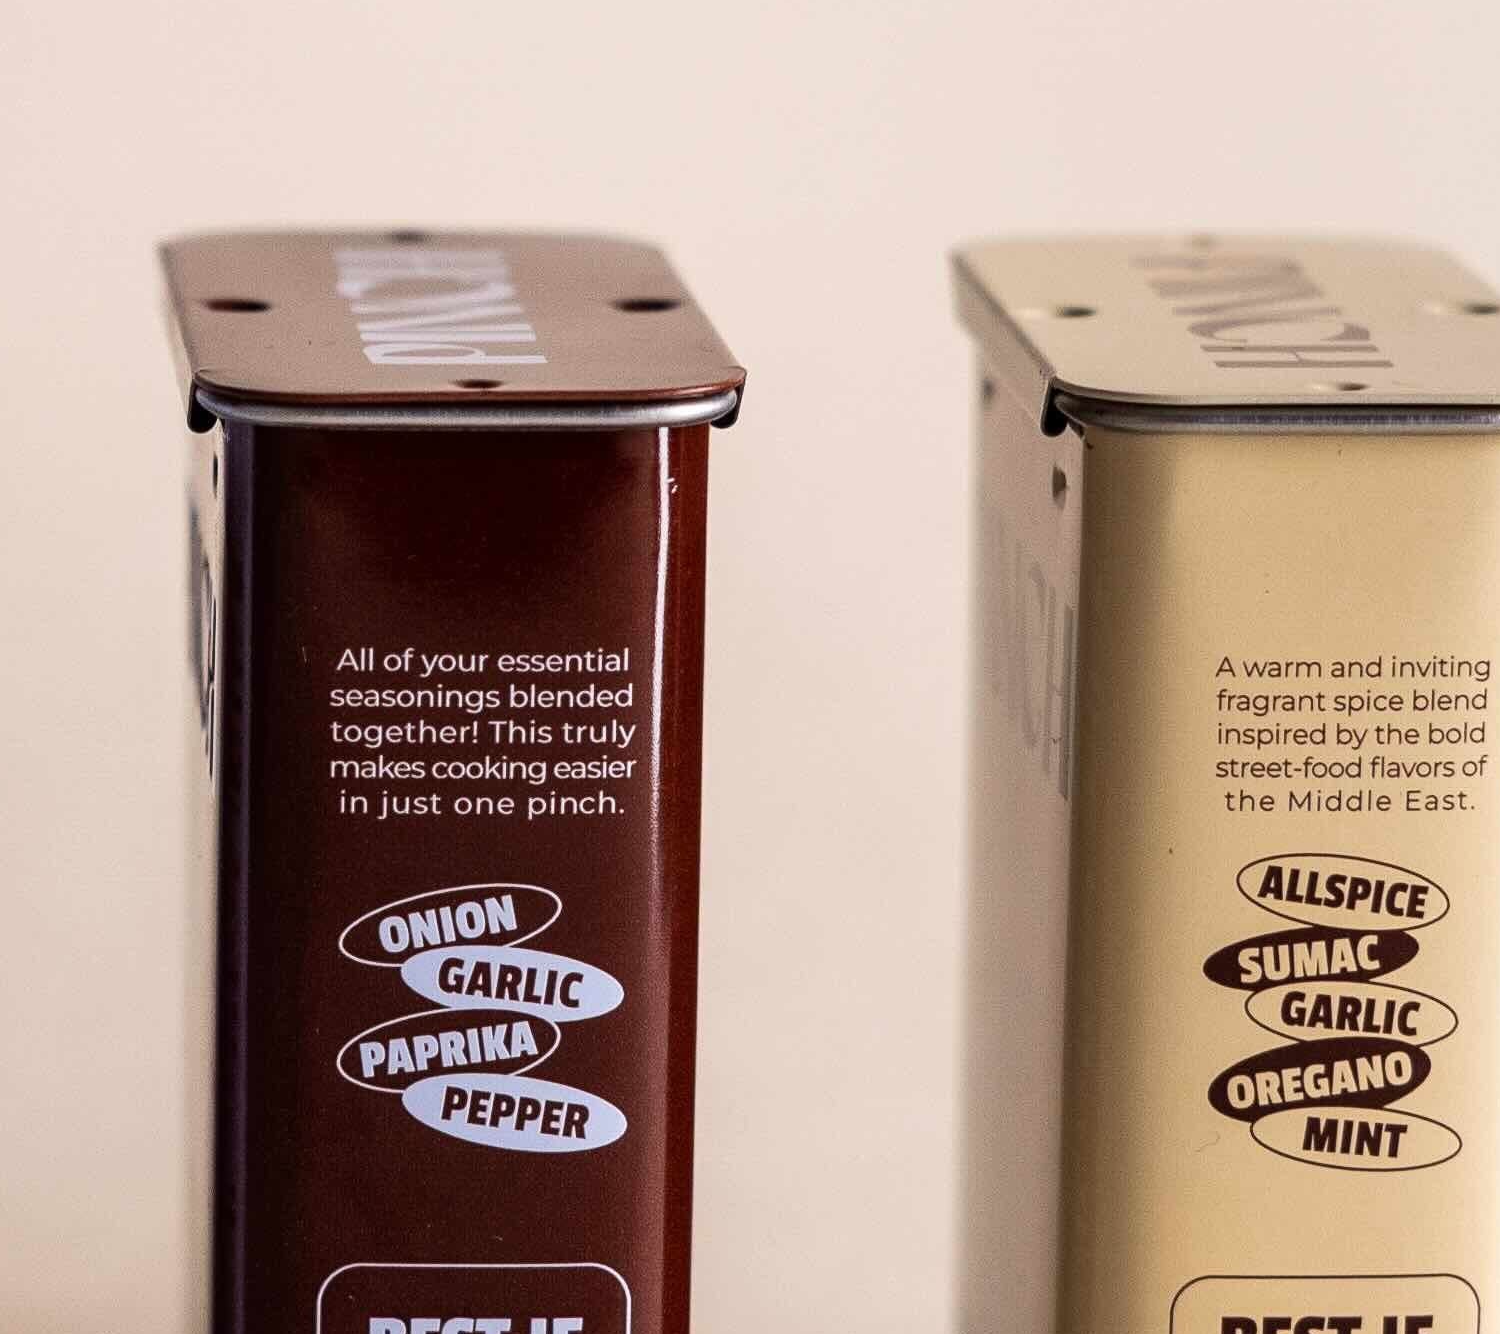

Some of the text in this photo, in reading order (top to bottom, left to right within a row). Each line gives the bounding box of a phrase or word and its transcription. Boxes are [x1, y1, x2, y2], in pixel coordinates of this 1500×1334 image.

[336, 647, 629, 678] All of your essential
[1215, 655, 1491, 683] A warm and inviting
[329, 682, 633, 714] seasonings blended
[1216, 687, 1488, 717] fragrant spice blend
[330, 719, 637, 749] together! This truly
[1218, 721, 1486, 751] inspired by the bold
[1256, 864, 1430, 920] ALLSPICE
[378, 894, 518, 954] ONION
[436, 957, 585, 1008] GARLIC
[1237, 934, 1381, 985] SUMAC
[1280, 991, 1422, 1037] GARLIC
[359, 1020, 539, 1079] PAPRIKA
[1226, 1049, 1413, 1111] OREGANO
[440, 1085, 591, 1140] PEPPER
[1302, 1116, 1409, 1159] MINT
